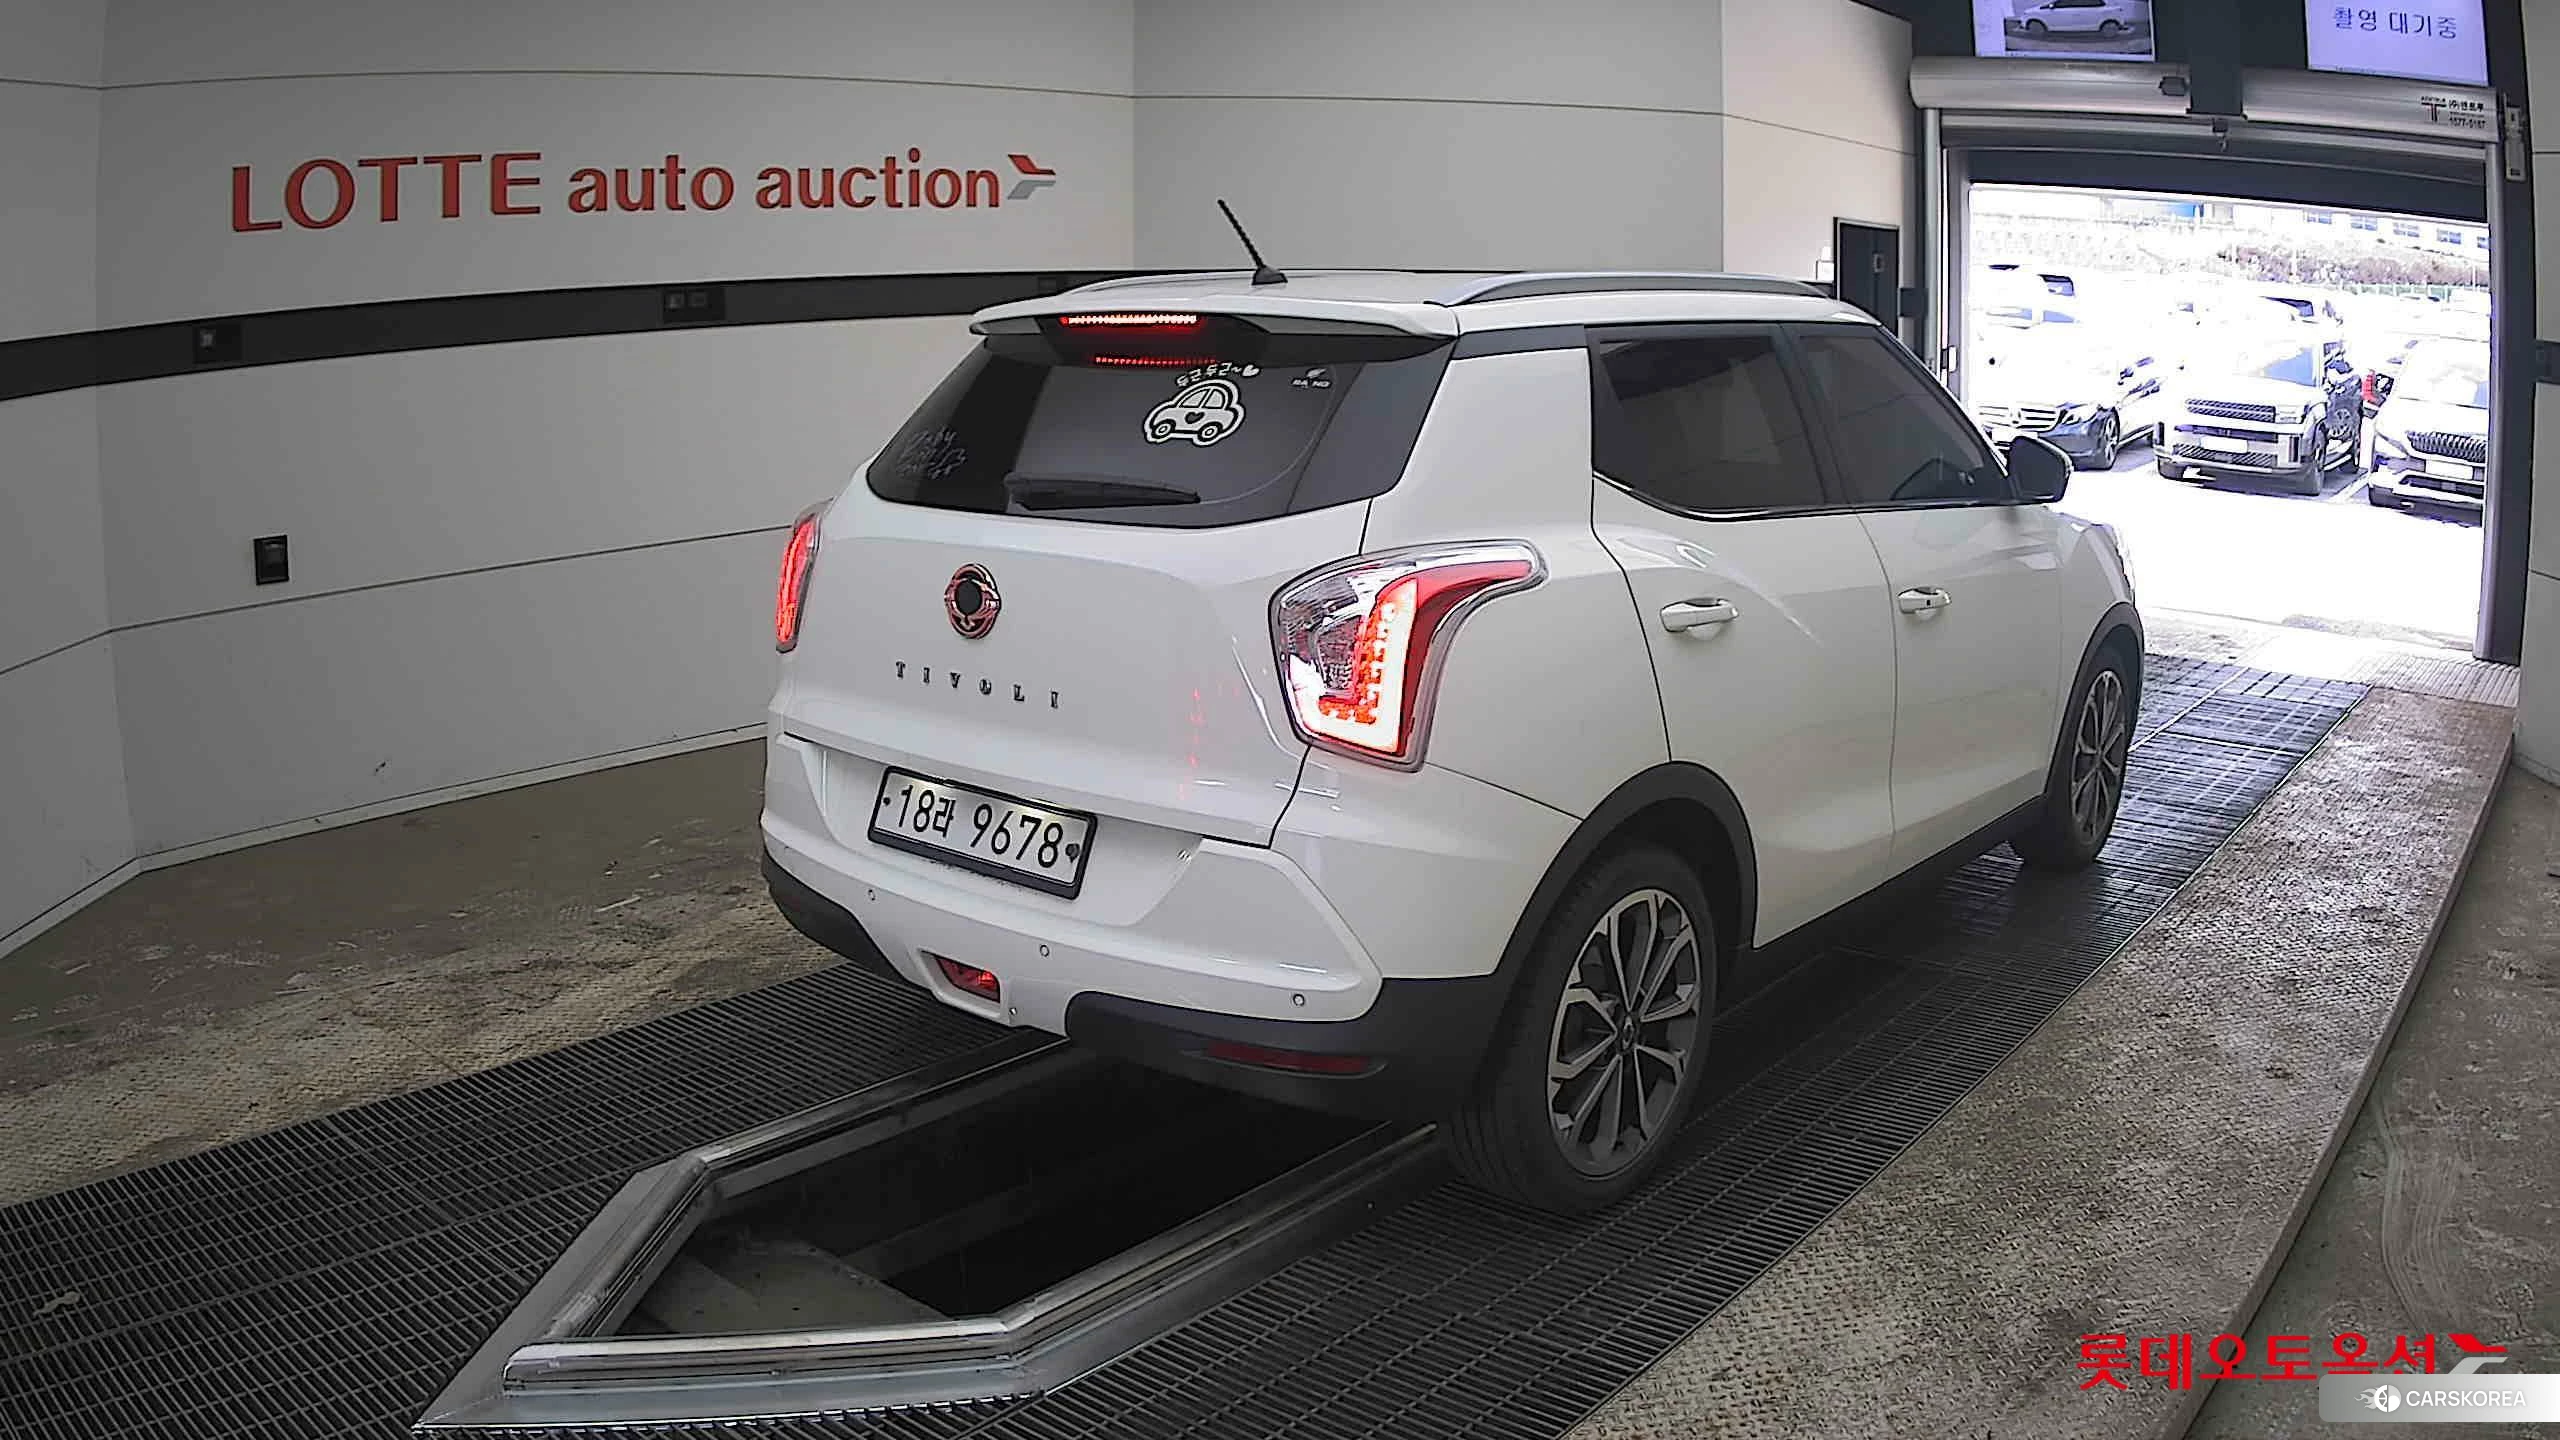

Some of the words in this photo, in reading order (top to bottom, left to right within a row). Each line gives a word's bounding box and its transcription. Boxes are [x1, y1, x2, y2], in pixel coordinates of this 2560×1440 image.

[2334, 6, 2377, 32] 촬영
[2389, 12, 2457, 40] 대기중
[231, 152, 541, 233] LOTTE
[568, 154, 734, 214] auto
[755, 148, 1001, 209] auction
[896, 660, 1061, 710] TIVOLI
[899, 784, 956, 838] 18라
[970, 803, 1064, 869] 9678
